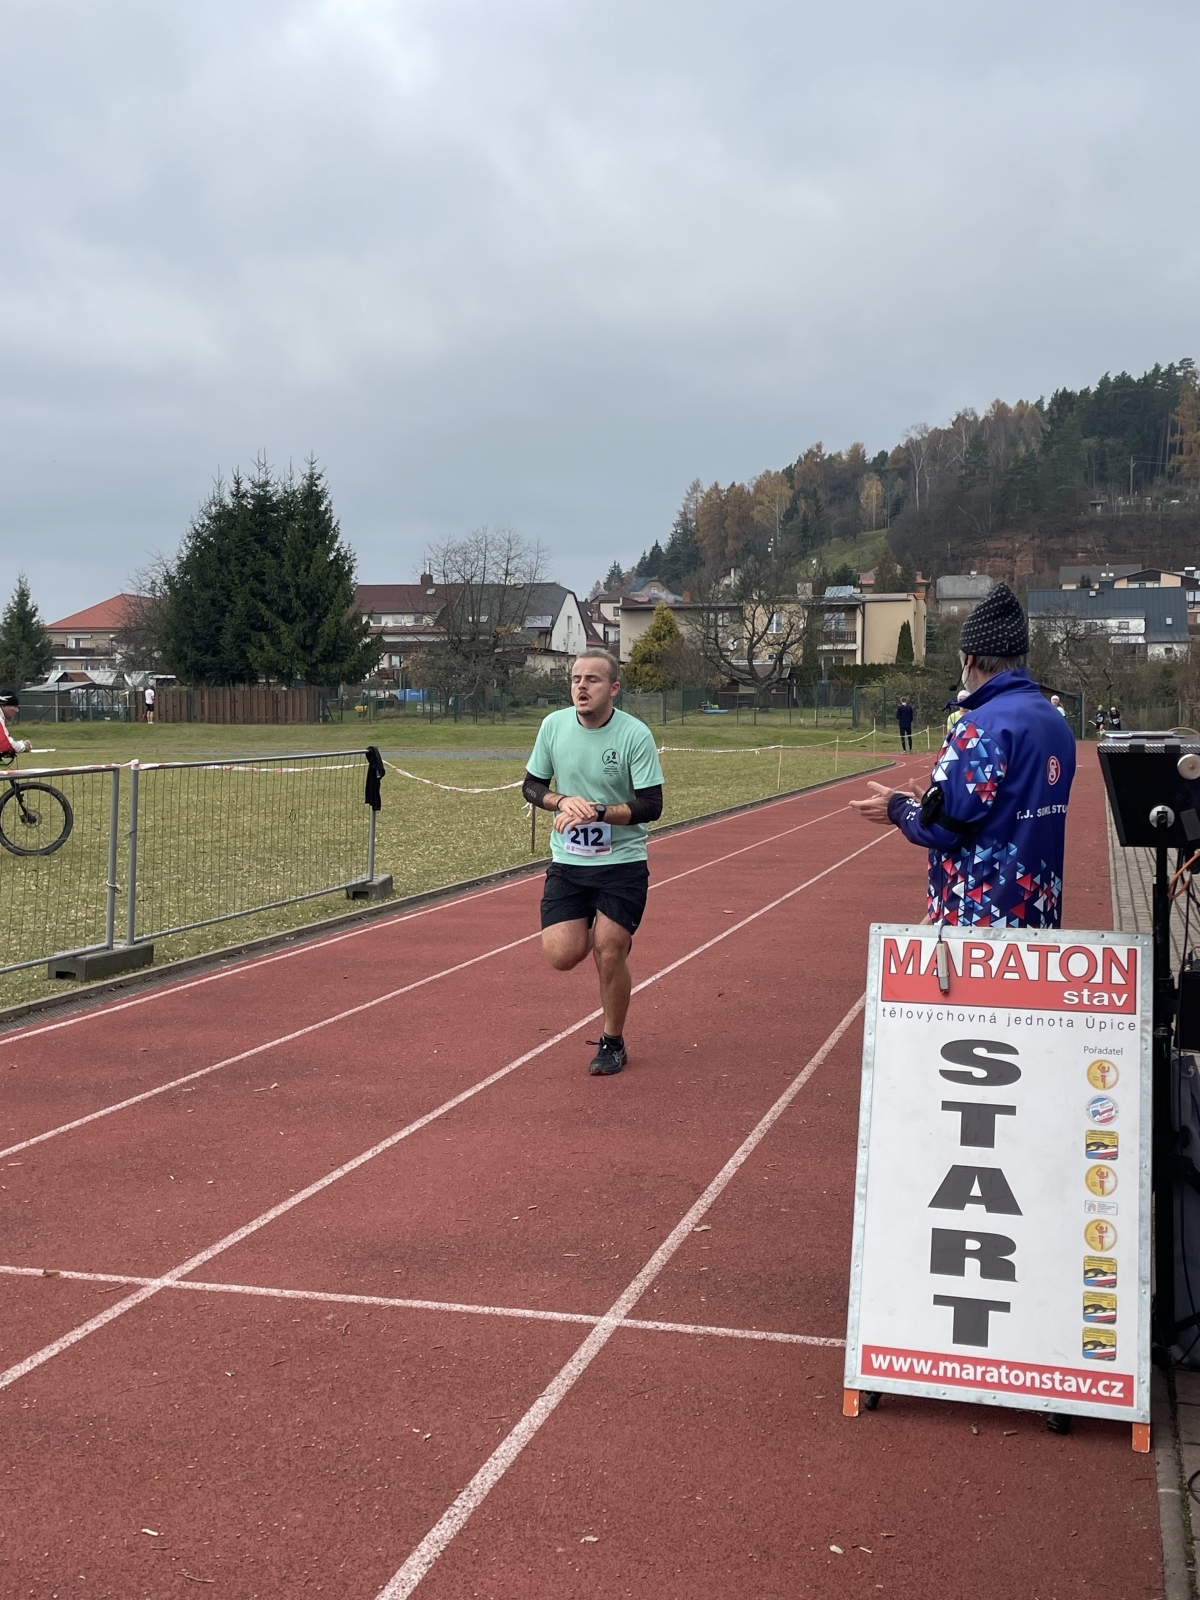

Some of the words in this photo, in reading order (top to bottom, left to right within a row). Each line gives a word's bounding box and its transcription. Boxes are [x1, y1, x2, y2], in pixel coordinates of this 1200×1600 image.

[570, 826, 605, 847] 212
[882, 938, 1137, 986] MARATON
[1062, 988, 1129, 1007] stav
[882, 1007, 997, 1024] tělovýchovná
[1006, 1013, 1074, 1028] jednota
[1085, 1015, 1136, 1032] Úpice
[927, 1038, 1023, 1348] START
[870, 1353, 1124, 1398] www.maratonstav.cz
